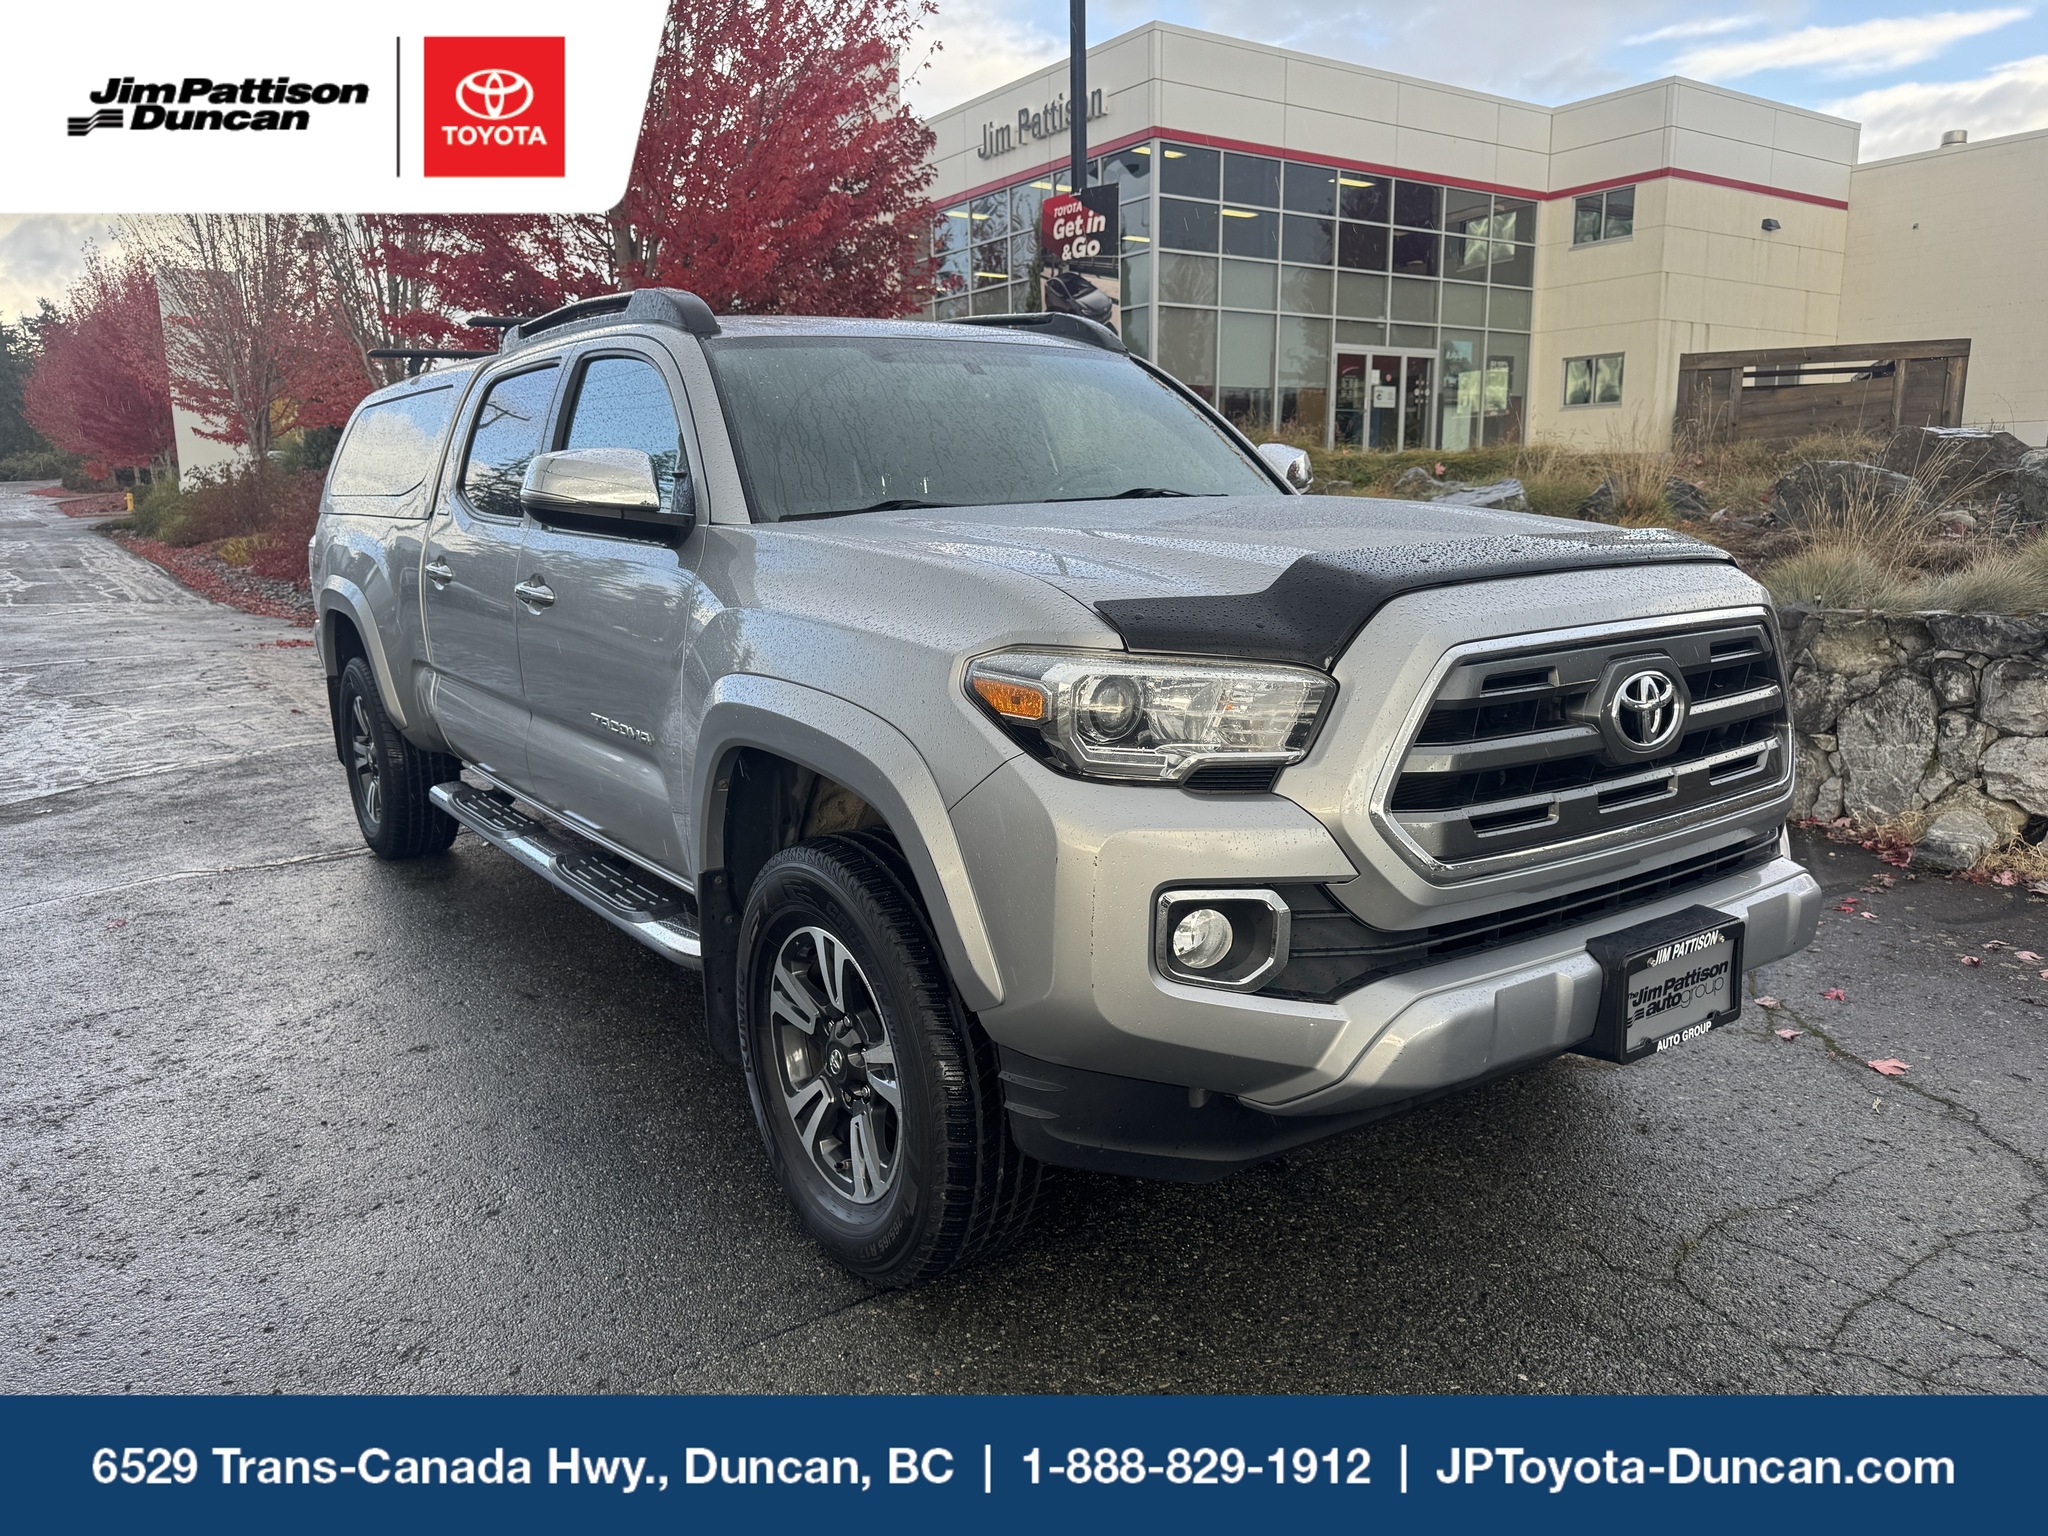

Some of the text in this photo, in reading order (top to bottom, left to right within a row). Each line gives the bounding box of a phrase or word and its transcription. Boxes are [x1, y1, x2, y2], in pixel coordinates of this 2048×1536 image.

[978, 121, 1011, 160] Jim
[1053, 201, 1083, 218] TOYOTA
[1053, 209, 1106, 240] Get in
[591, 712, 656, 746] TACOMA
[1654, 929, 1719, 967] JIM PATTISON
[1656, 1020, 1712, 1052] AUTO GROUP
[877, 1214, 904, 1252] 265/65
